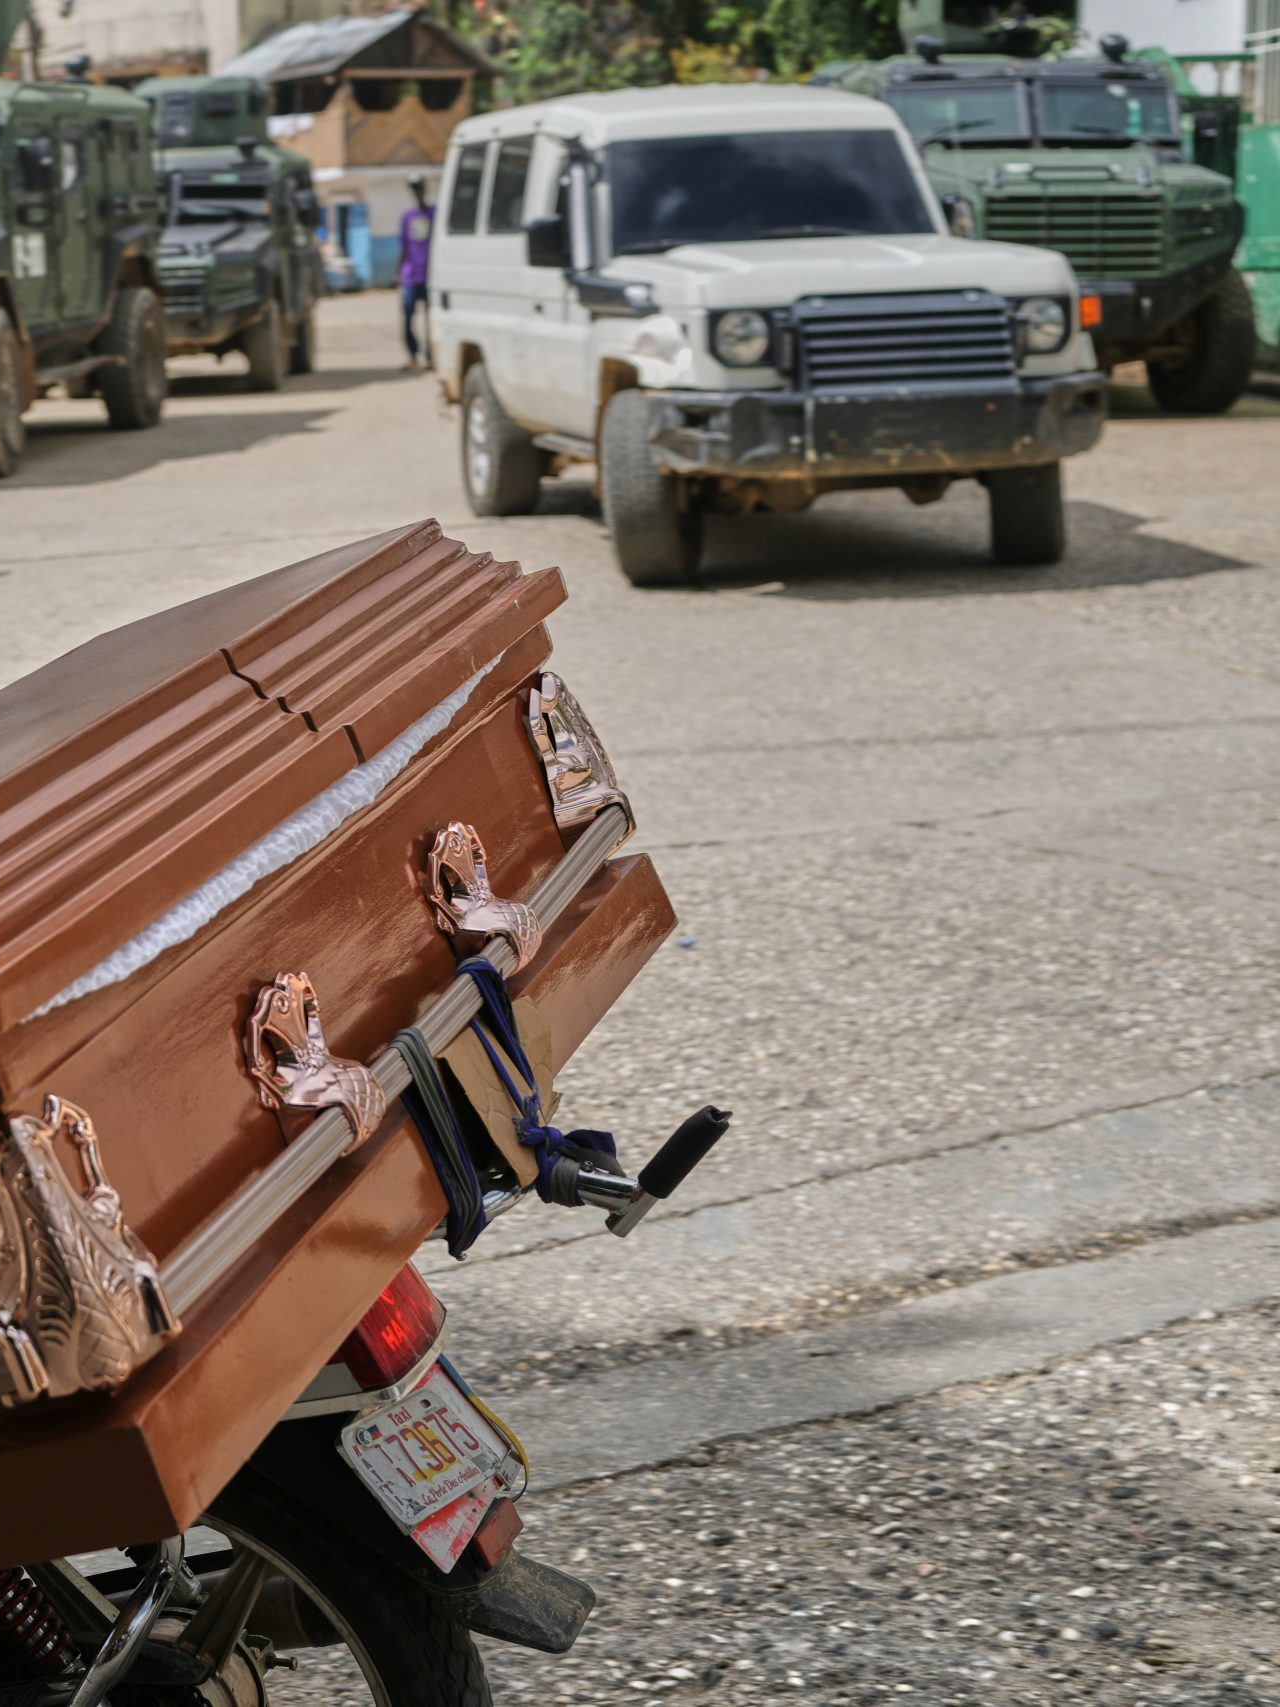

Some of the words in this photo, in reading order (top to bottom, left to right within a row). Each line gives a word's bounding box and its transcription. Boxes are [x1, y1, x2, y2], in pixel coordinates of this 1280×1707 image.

[387, 1407, 413, 1426] Taxi
[385, 1407, 480, 1479] 73675
[443, 1480, 459, 1491] Des
